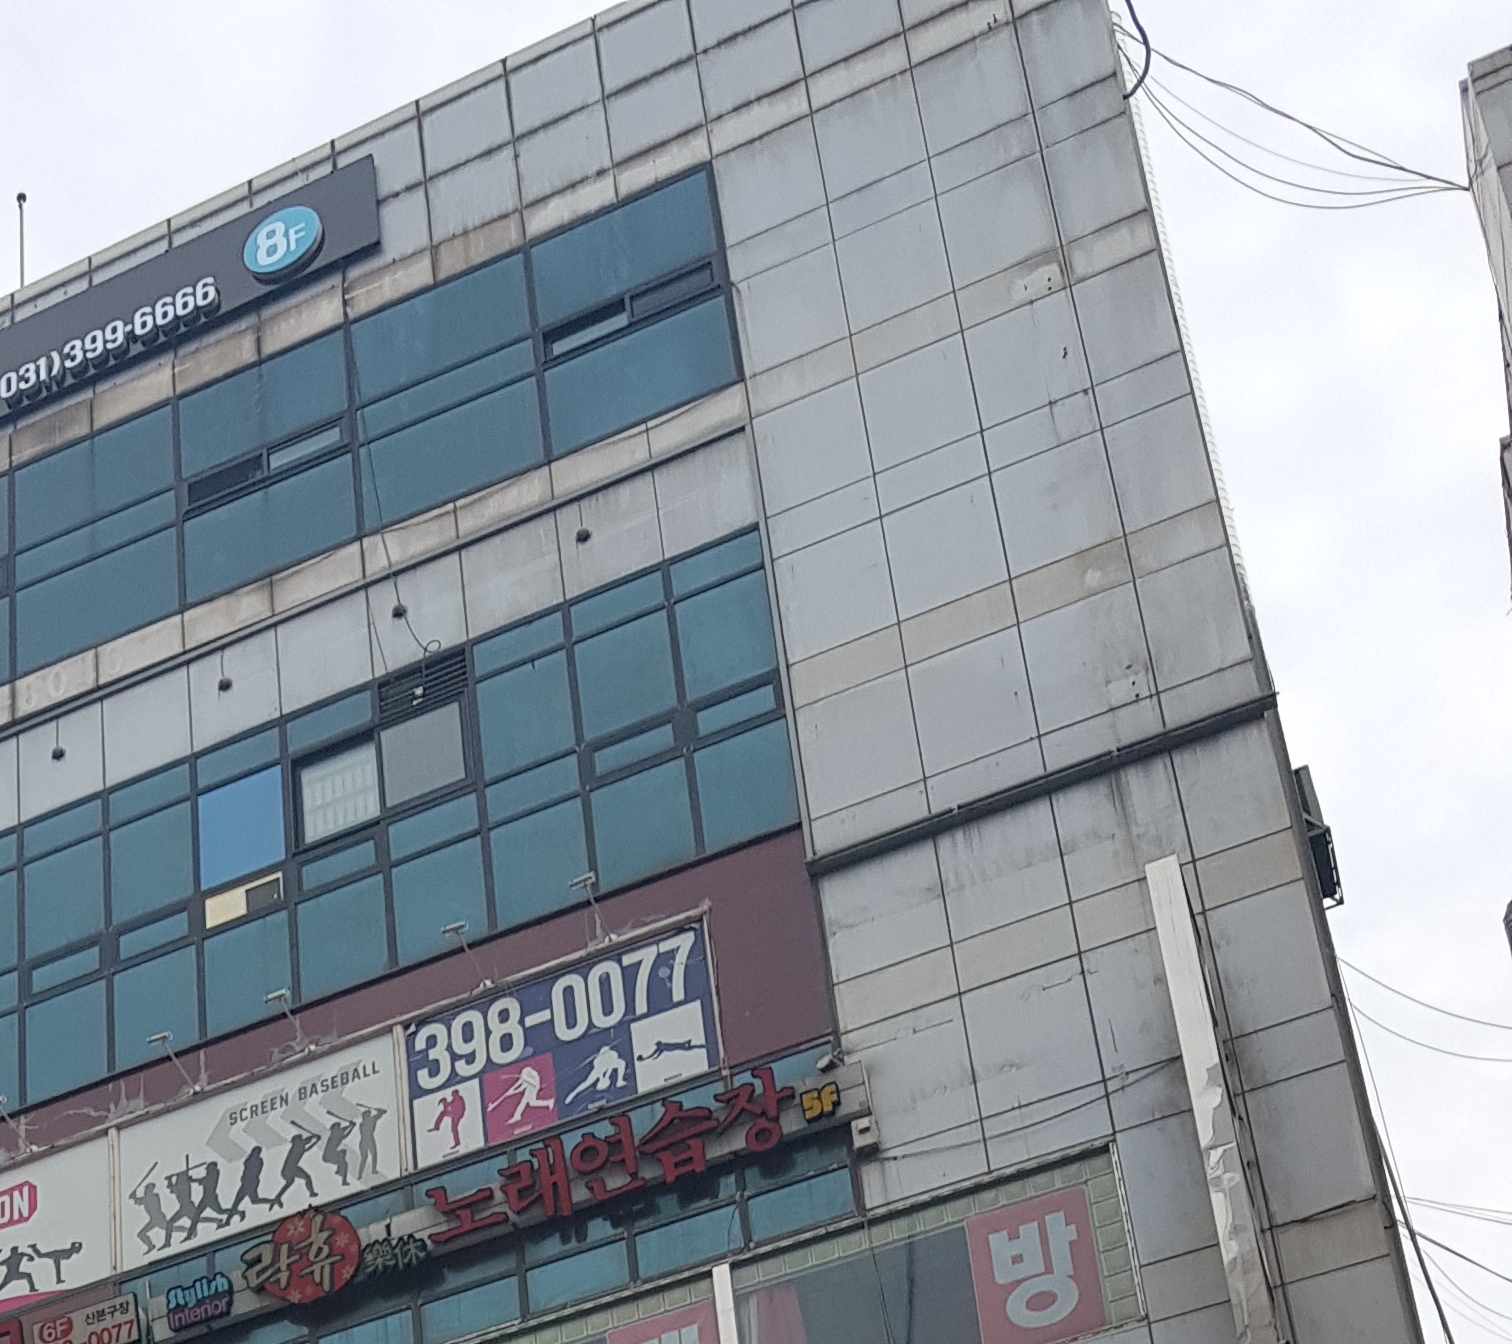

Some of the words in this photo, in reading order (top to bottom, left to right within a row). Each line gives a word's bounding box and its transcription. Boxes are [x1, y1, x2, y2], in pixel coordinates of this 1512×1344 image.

[254, 212, 310, 268] 8F
[412, 929, 695, 1093] 398-0077
[227, 1091, 291, 1128] SCREEN
[296, 1060, 382, 1103] BASEBALL
[800, 1084, 839, 1124] 5F
[426, 1065, 795, 1245] 노래연습장
[83, 1299, 131, 1328] 산본구장
[166, 1272, 233, 1312] Stylish
[40, 1316, 73, 1344] 6F
